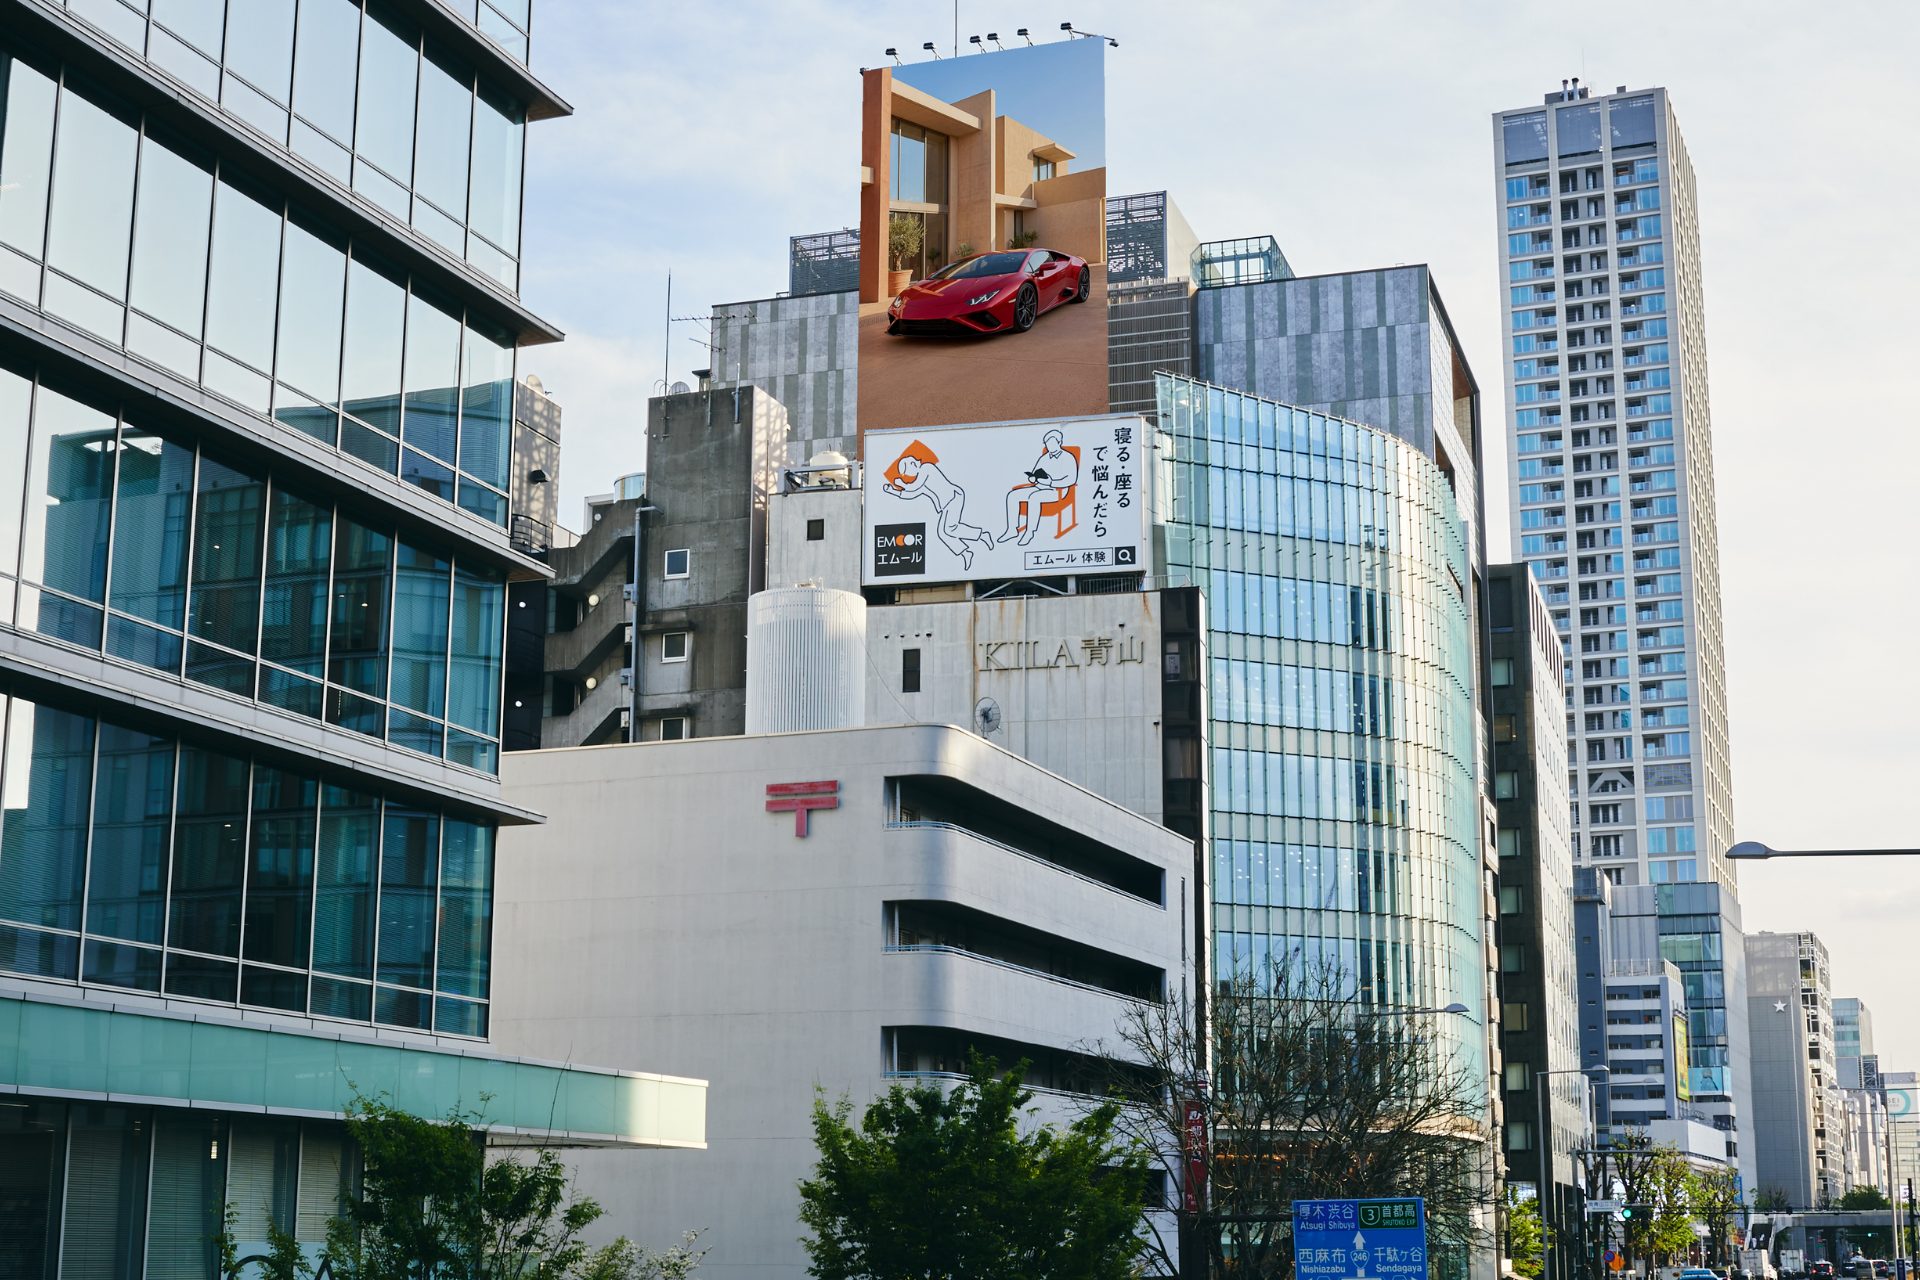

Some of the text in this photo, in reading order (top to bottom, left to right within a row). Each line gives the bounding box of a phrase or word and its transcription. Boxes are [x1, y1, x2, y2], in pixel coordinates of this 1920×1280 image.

[1114, 427, 1132, 508] 寝る・座る
[1091, 446, 1109, 538] で悩んだら
[877, 534, 923, 547] EMOOR
[877, 552, 922, 565] エムール
[1033, 551, 1106, 565] エムール 体験
[1300, 1204, 1354, 1219] 厚木 渋谷
[1367, 1209, 1375, 1220] 3
[1382, 1204, 1415, 1218] 首都高
[1300, 1221, 1355, 1231] Atsugi Shibuya
[1299, 1248, 1346, 1263] 西麻布
[1353, 1252, 1367, 1261] 246
[1301, 1265, 1346, 1274] Nishiazabu
[1376, 1264, 1422, 1273] Sendagaya
